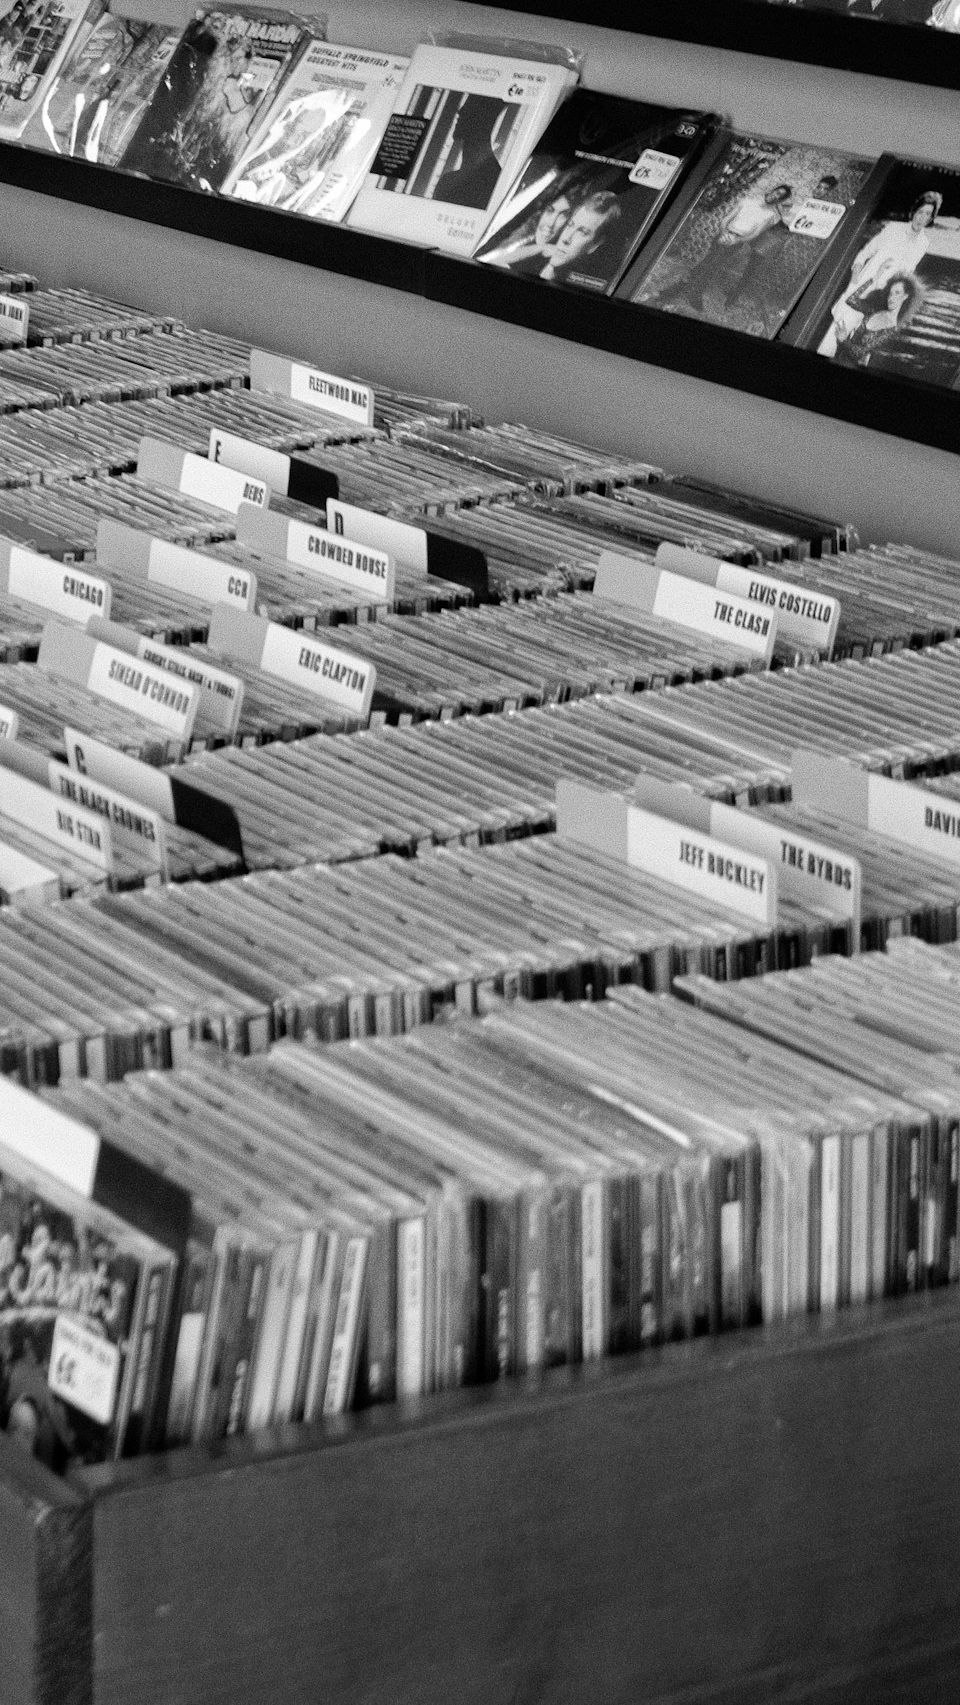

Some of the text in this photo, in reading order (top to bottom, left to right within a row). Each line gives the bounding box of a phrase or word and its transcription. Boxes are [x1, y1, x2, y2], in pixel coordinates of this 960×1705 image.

[7, 304, 24, 321] JOHN
[308, 375, 368, 408] FLEETWOOD MAC
[242, 481, 265, 505] DEUS
[307, 534, 387, 580] CROWDED HOUSE
[62, 574, 104, 608] CHICAGO
[227, 575, 249, 600] CCR
[748, 581, 832, 624] ELVIS COSTELLO
[713, 600, 771, 637] THE CLASH
[107, 658, 191, 715] SINEAD O'CONNOR
[298, 646, 366, 694] ERIC CLAPTON
[55, 809, 102, 851] BIG STAR
[78, 784, 111, 820] BLACK
[111, 802, 156, 843] CROWES
[678, 839, 765, 895] JEFF BUCKLEY
[780, 839, 853, 891] THE BYRDS
